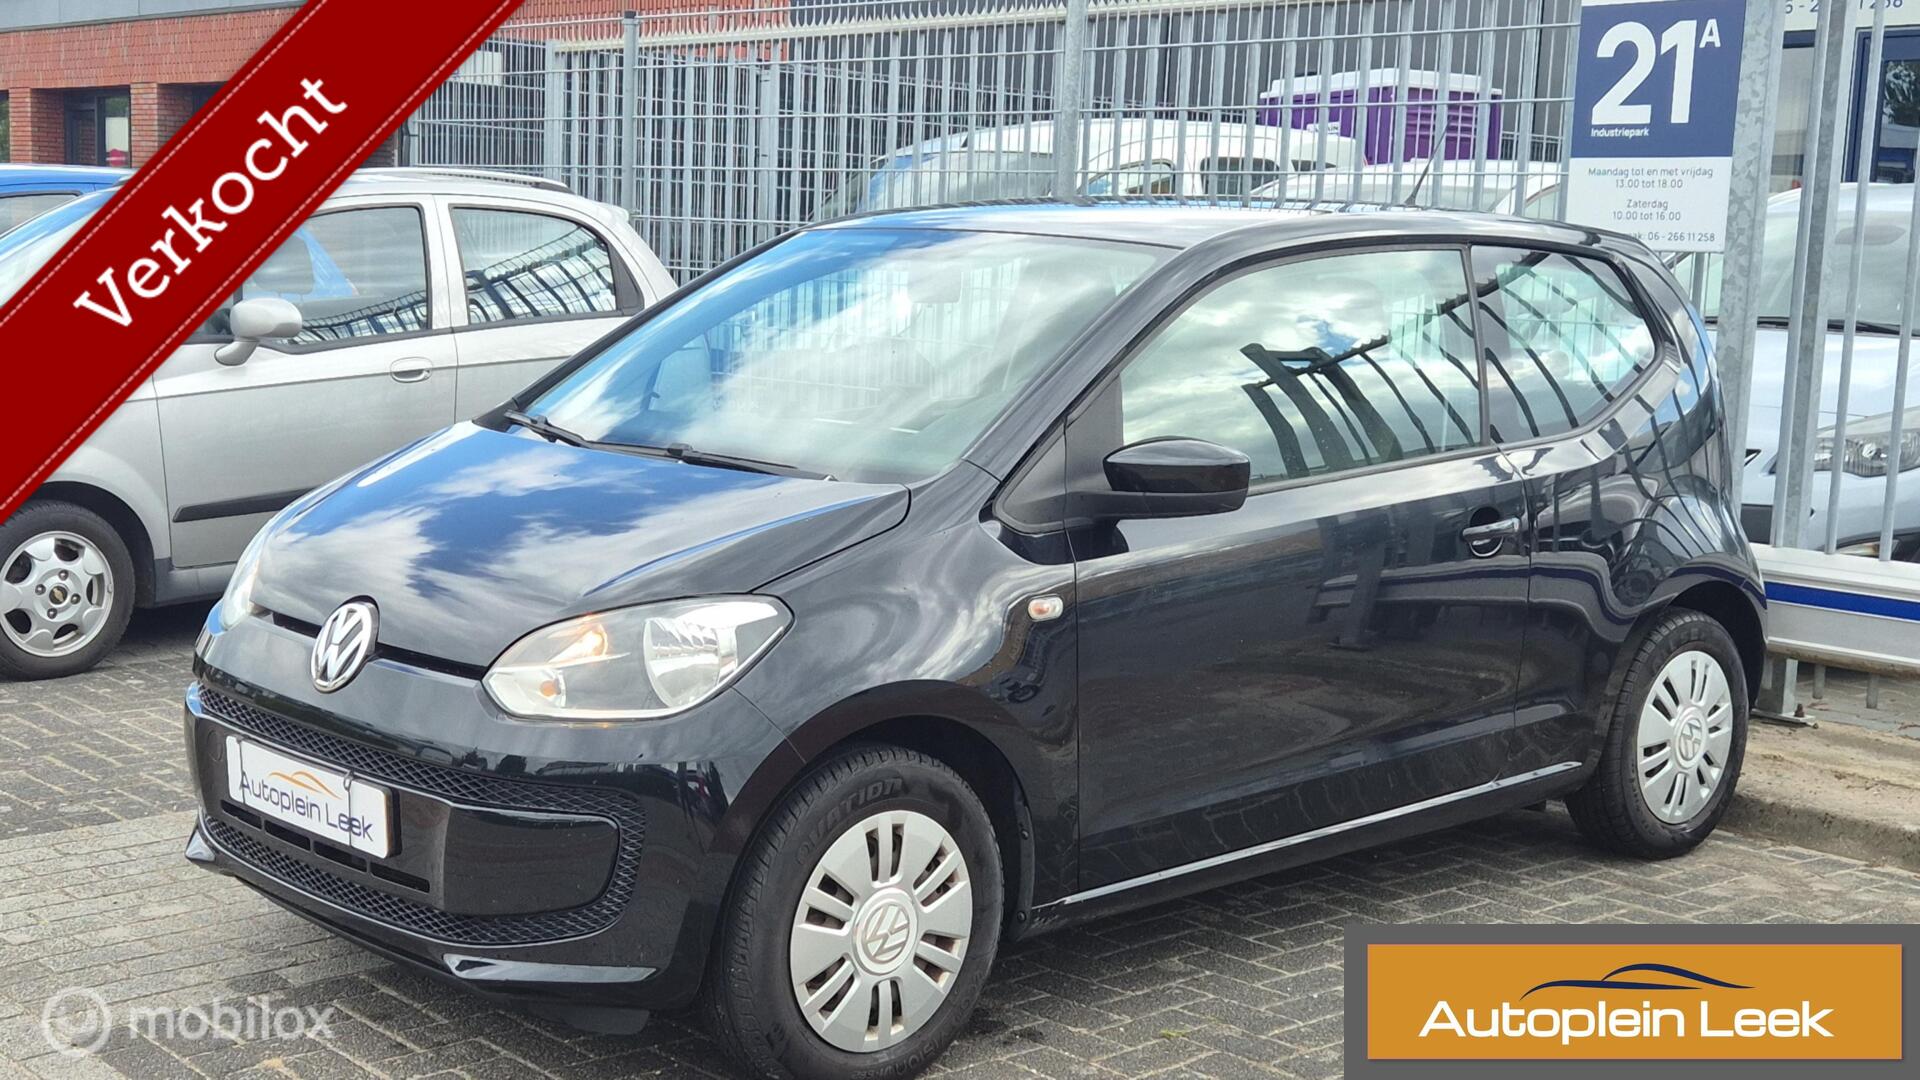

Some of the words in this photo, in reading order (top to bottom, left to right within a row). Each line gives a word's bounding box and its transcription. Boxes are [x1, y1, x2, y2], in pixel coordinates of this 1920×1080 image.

[1591, 127, 1650, 139] Industriepark
[1588, 167, 1629, 178] Maandag
[1631, 168, 1645, 177] tot
[1646, 168, 1659, 177] en
[1660, 168, 1679, 177] met
[1680, 167, 1714, 179] vrijdag
[1641, 179, 1655, 189] tot
[1626, 199, 1669, 211] Zaterdag
[1639, 211, 1653, 221] tot
[1647, 231, 1660, 242] 06
[1667, 231, 1686, 242] 266
[1697, 232, 1716, 243] 258
[240, 770, 321, 823] Autoplein
[325, 801, 374, 842] Leek
